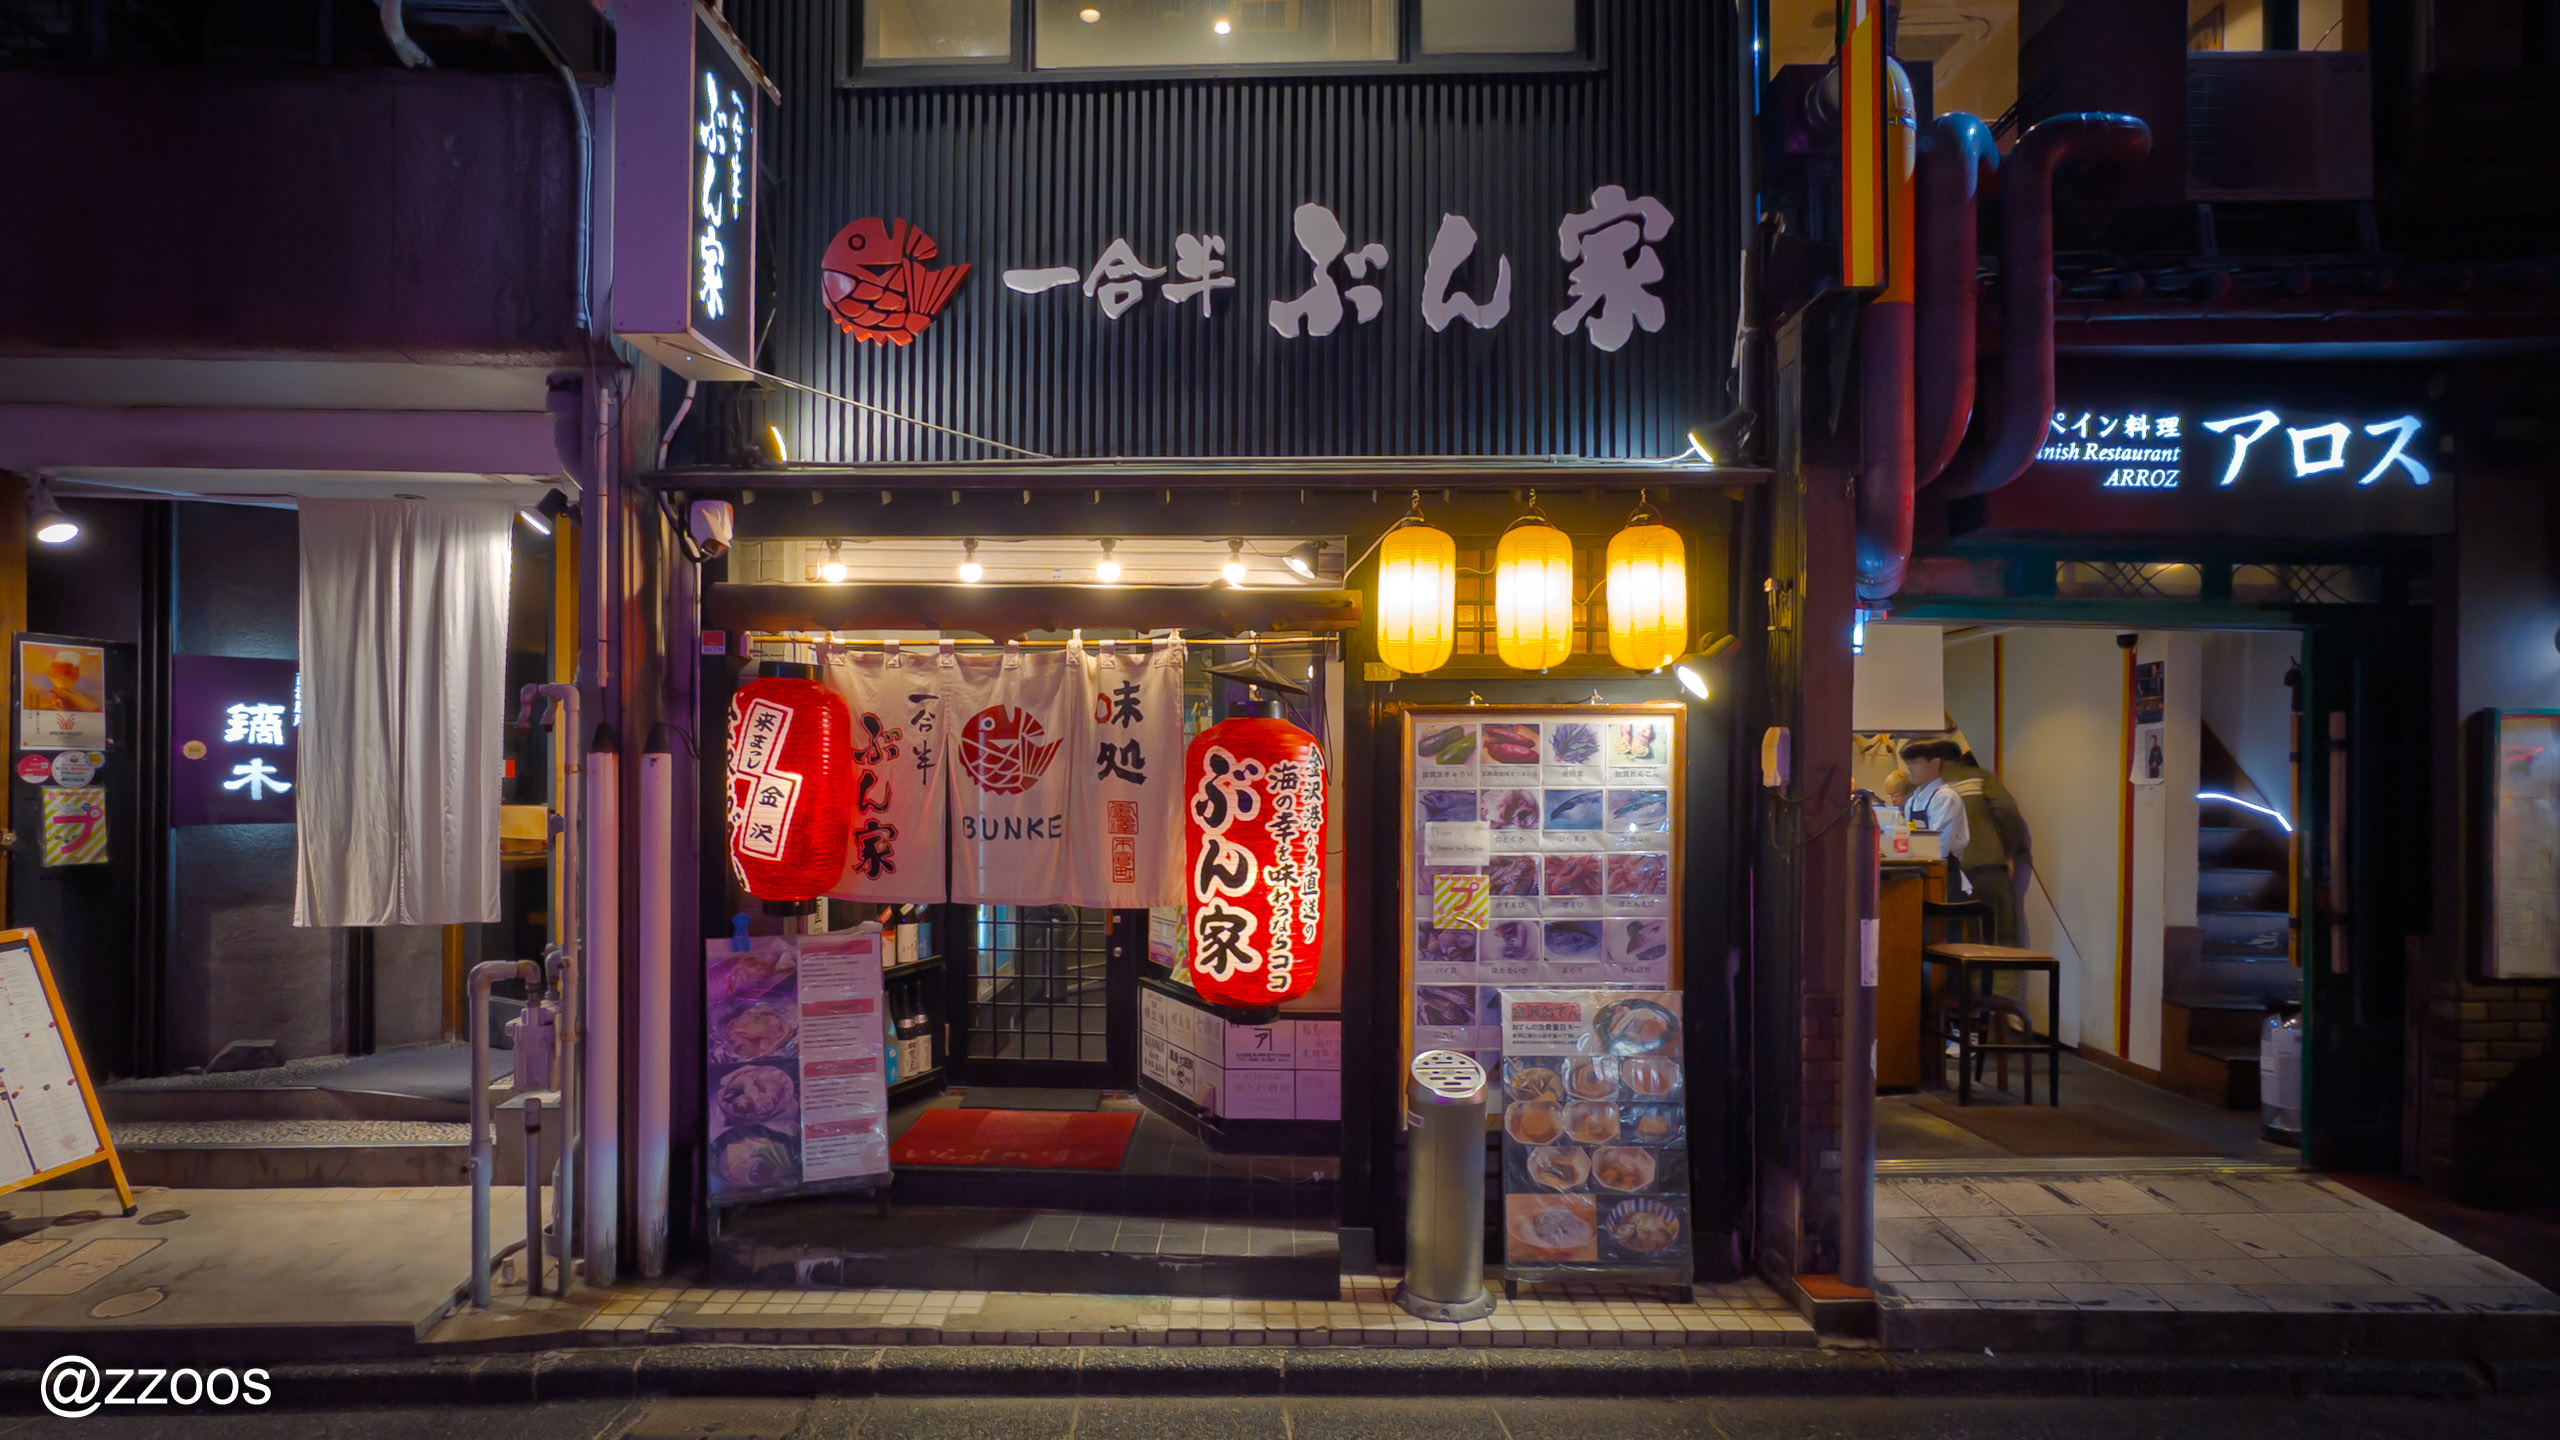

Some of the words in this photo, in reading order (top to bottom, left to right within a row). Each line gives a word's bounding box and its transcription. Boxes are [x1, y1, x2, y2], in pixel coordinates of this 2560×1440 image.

[700, 71, 727, 320] ぶん家
[1002, 233, 1236, 319] 一合半
[1269, 184, 1674, 352] ぶん家
[2083, 442, 2181, 461] Restaurant
[2103, 468, 2180, 488] ARROZ
[2202, 409, 2432, 487] アロス
[908, 693, 939, 785] 一合半
[1095, 680, 1147, 785] 味処
[749, 785, 785, 844] 金沢
[852, 712, 902, 880] ぶん家
[963, 814, 1063, 841] BUNKE
[1196, 752, 1259, 976] ぶん家
